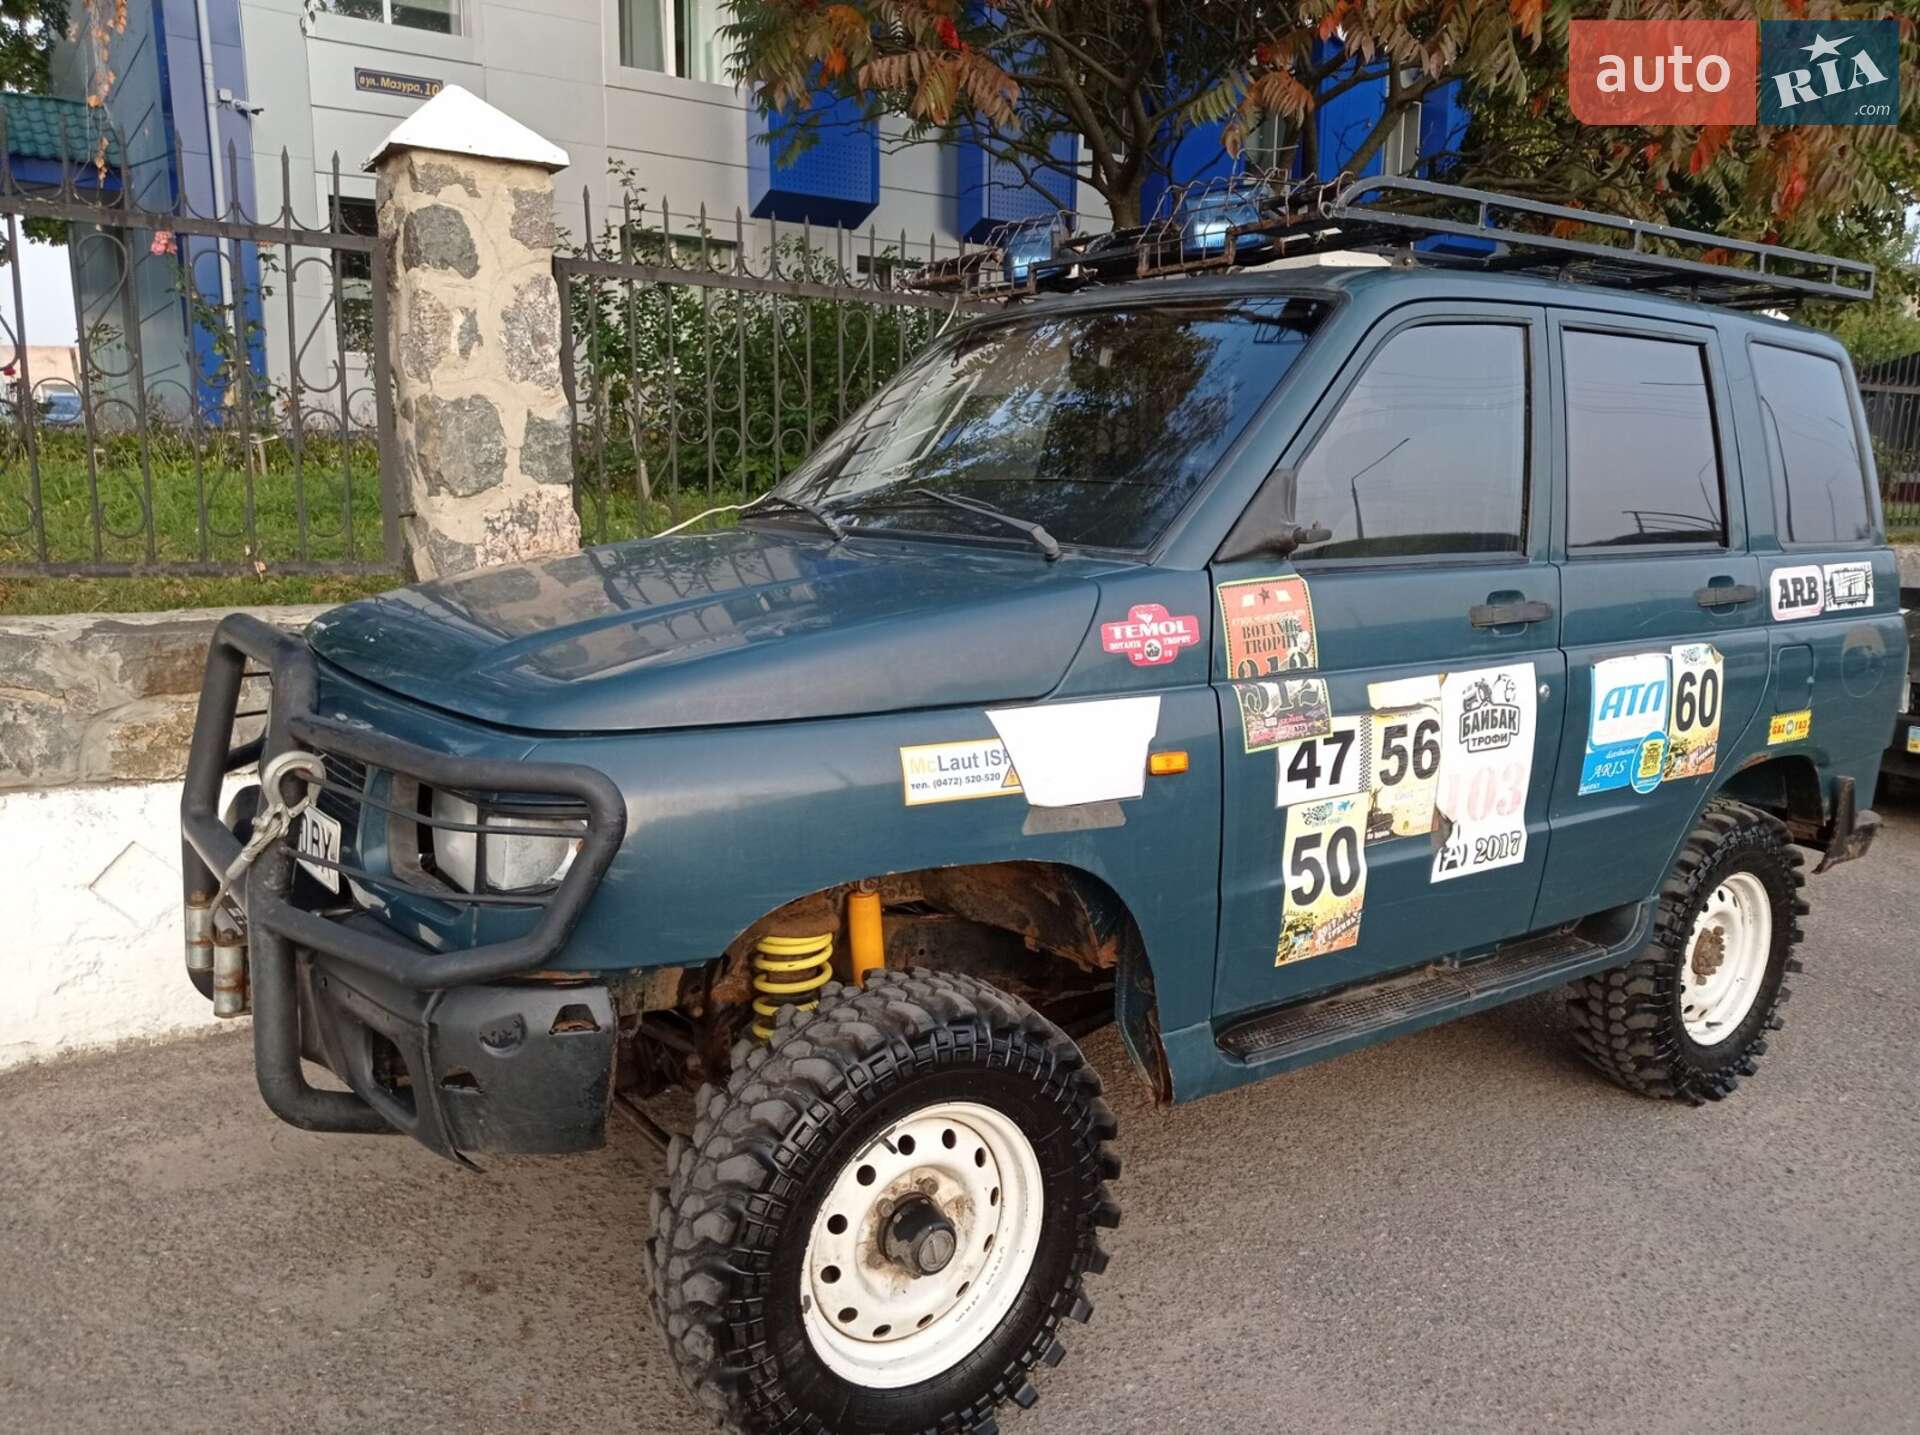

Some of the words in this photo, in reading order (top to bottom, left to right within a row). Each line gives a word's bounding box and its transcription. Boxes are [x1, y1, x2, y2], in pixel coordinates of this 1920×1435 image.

[1778, 576, 1819, 610] ARB
[1108, 620, 1192, 640] TEMOL
[1676, 669, 1718, 732] 60
[909, 752, 980, 775] McLaut
[1287, 730, 1355, 789] 47
[1379, 719, 1440, 786] 56
[933, 777, 962, 790] (0472)
[965, 772, 1001, 784] 520-520
[1473, 830, 1522, 864] 2017
[1291, 826, 1361, 906] 50
